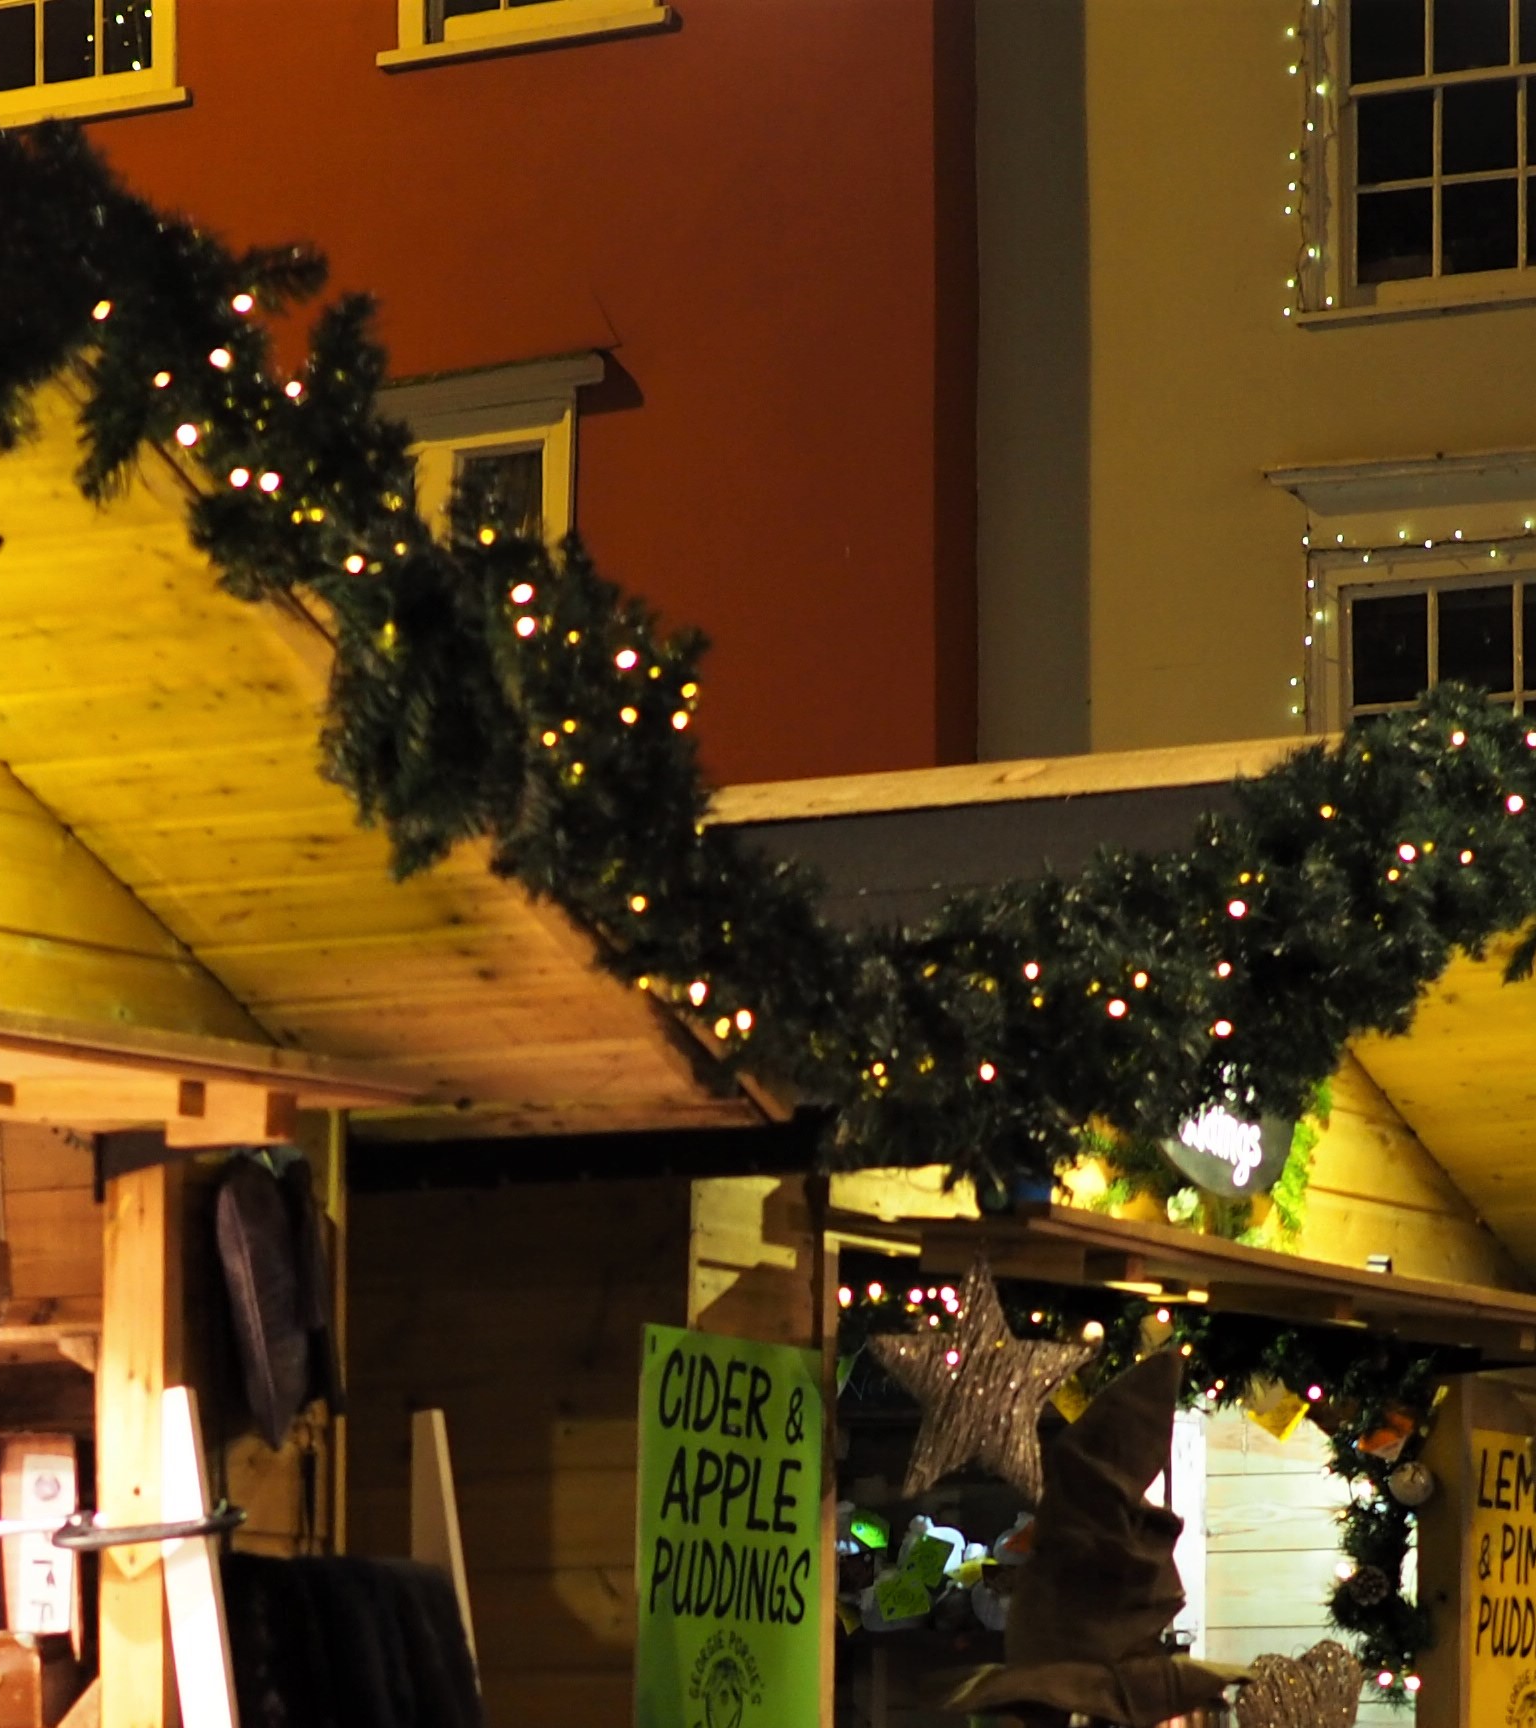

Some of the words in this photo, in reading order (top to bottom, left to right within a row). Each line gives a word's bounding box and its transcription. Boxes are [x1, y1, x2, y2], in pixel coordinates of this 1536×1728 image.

[658, 1348, 772, 1442] CIDER
[785, 1386, 805, 1445] &
[660, 1446, 802, 1535] APPLE
[649, 1536, 811, 1626] PUDDINGS
[1478, 1532, 1491, 1581] &
[688, 1629, 724, 1701] GEORGIE
